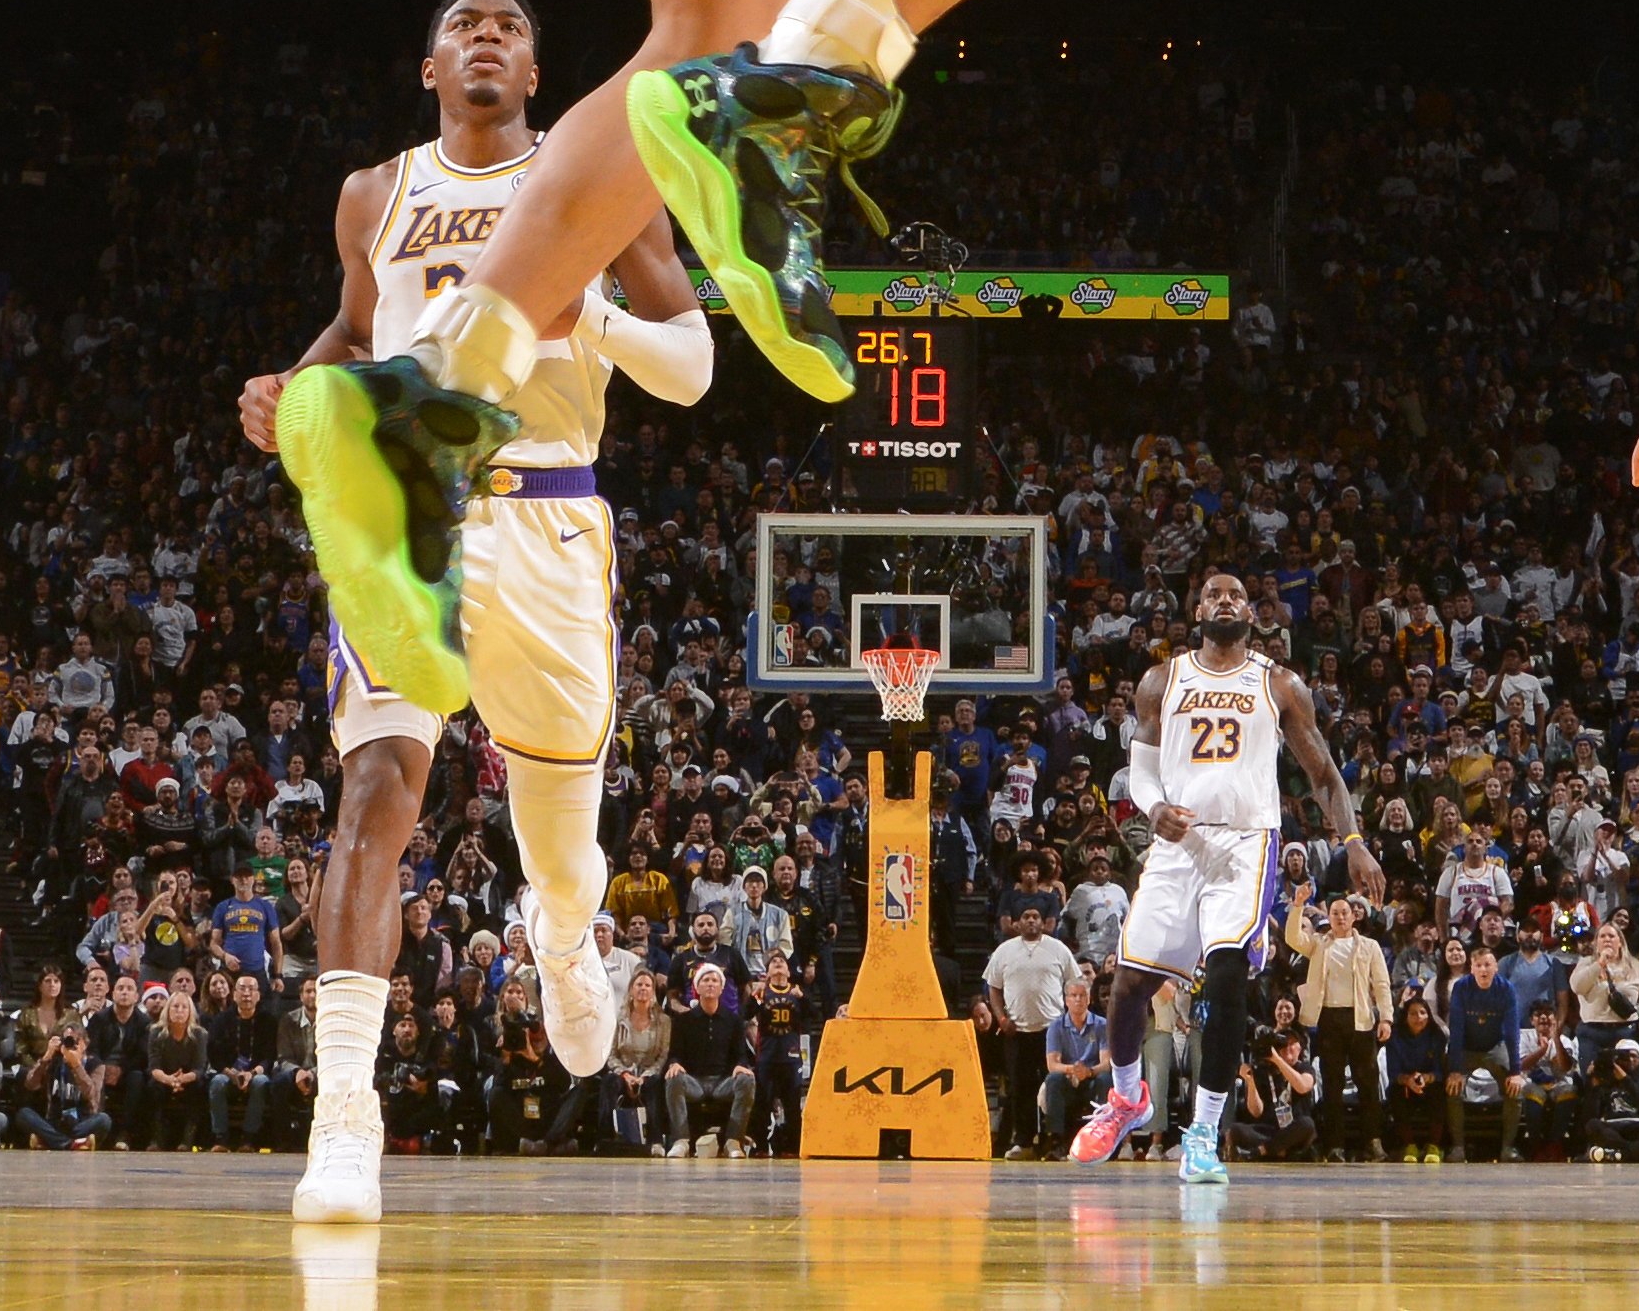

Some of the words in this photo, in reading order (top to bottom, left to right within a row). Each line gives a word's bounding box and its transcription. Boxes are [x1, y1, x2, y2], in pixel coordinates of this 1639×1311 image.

[390, 205, 504, 264] LAKE
[976, 276, 1024, 306] Starry
[1070, 278, 1117, 307] Starry
[1165, 281, 1211, 310] Starry
[857, 331, 932, 364] 26.7
[890, 367, 946, 427] 18
[879, 441, 961, 458] TISSOT
[1173, 687, 1256, 714] LAKERS
[1190, 717, 1241, 763] 23
[1010, 787, 1030, 805] 30
[833, 1066, 954, 1097] KIA
